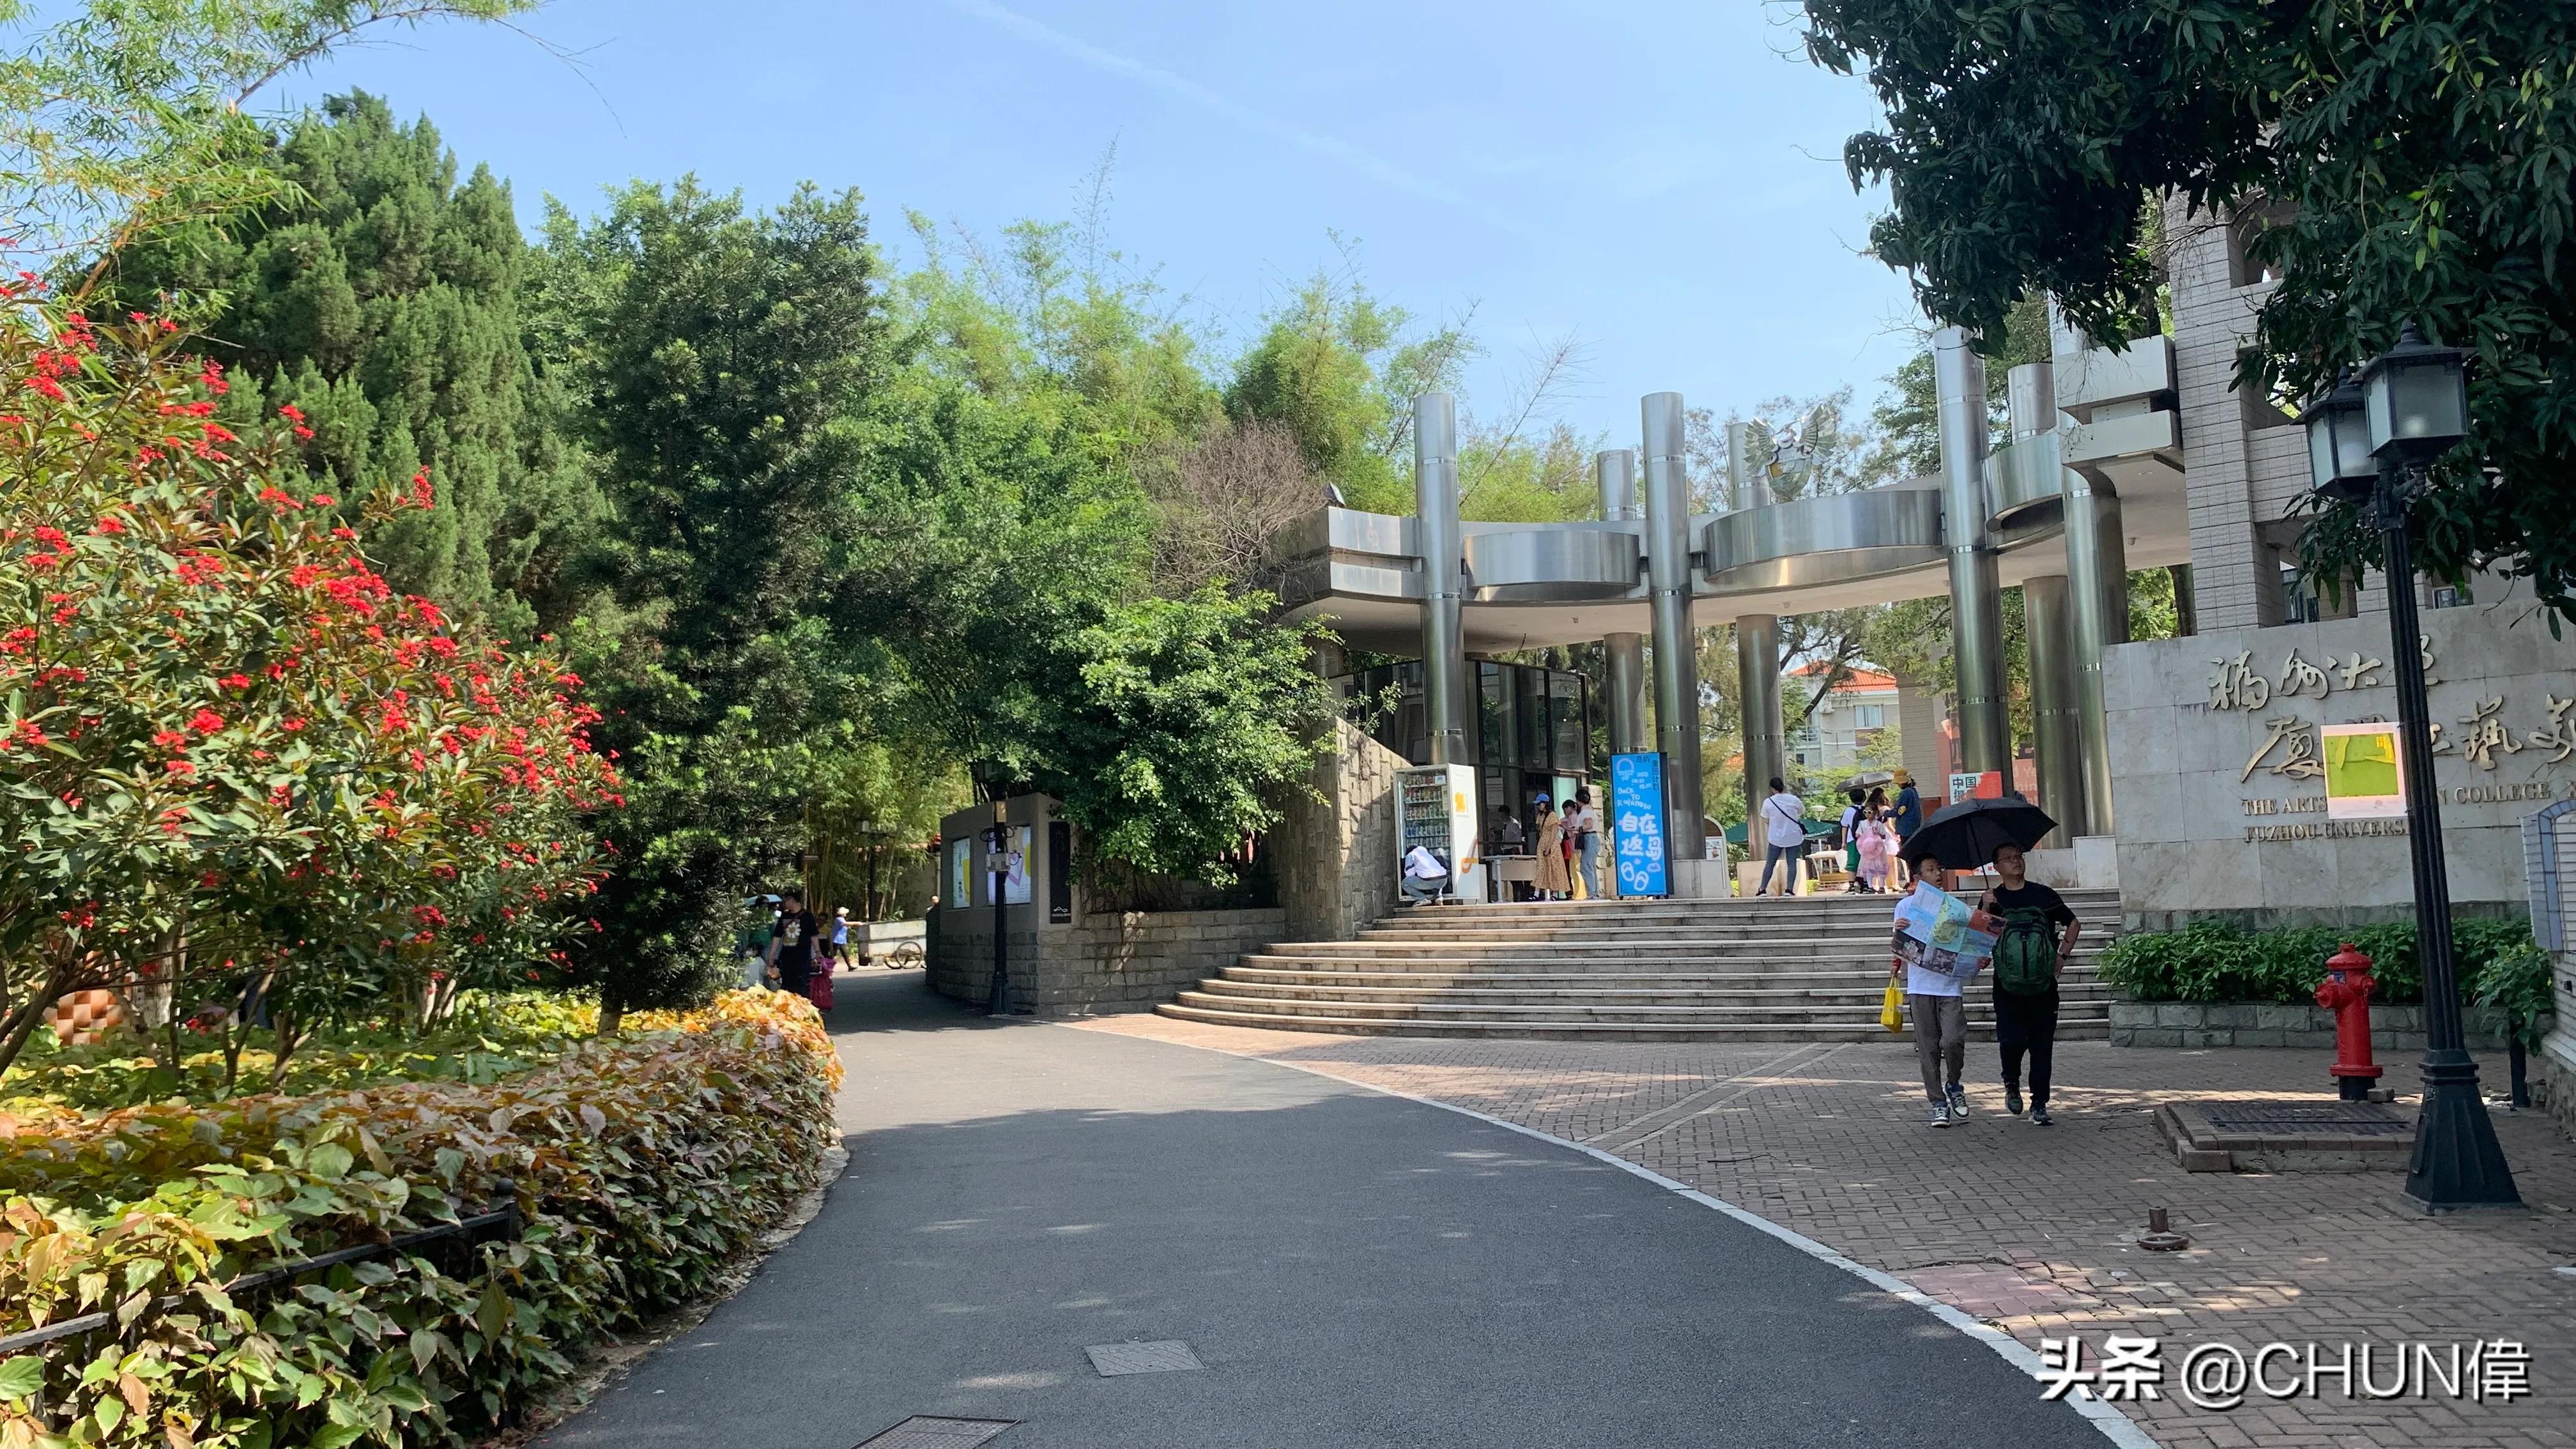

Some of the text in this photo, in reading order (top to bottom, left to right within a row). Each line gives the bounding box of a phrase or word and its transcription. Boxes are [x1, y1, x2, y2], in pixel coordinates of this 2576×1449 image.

[1952, 776, 1977, 789] 中国
[2242, 798, 2278, 816] THE
[2453, 781, 2551, 804] COLLEGE
[1621, 811, 1659, 835] 自在
[2244, 823, 2317, 842] FUZHOU
